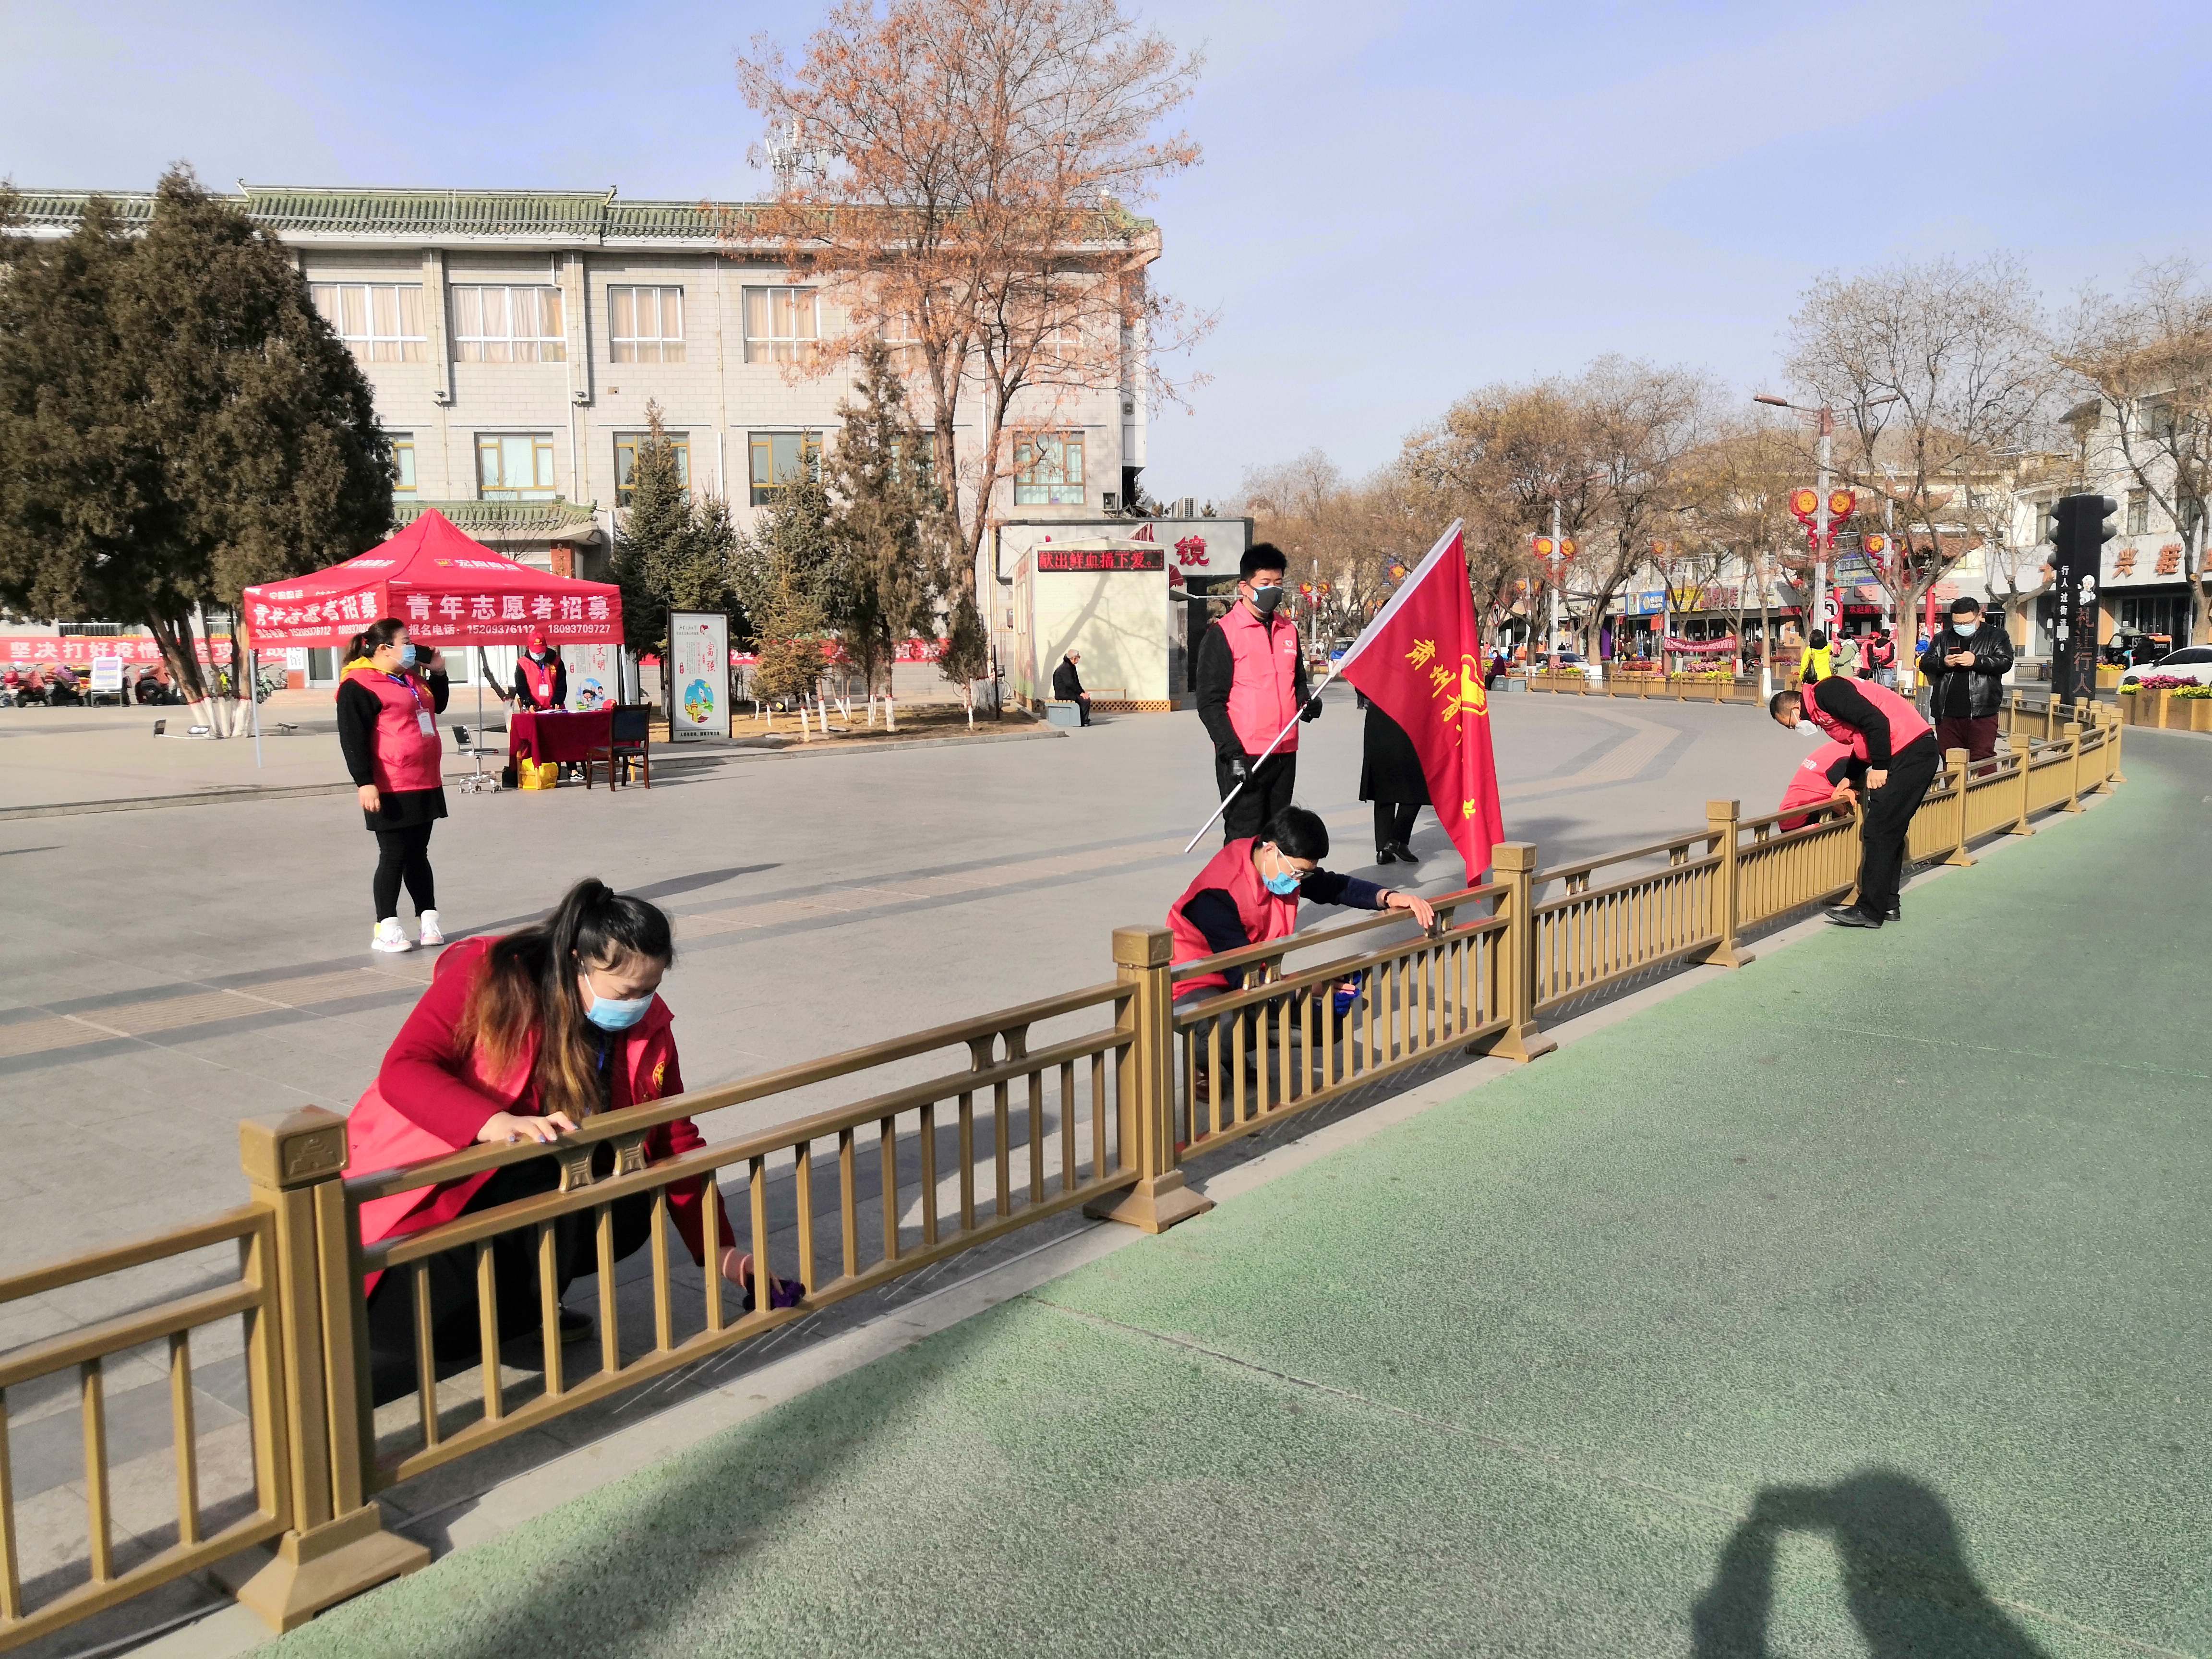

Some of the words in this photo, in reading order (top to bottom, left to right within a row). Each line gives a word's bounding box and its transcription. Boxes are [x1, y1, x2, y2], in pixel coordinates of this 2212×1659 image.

[1039, 552, 1152, 568] 献出鲜血播下爱。
[1174, 535, 1210, 566] 镜
[253, 591, 378, 626] 青年志愿者招募
[406, 593, 611, 621] 青年志愿者招募
[2059, 565, 2069, 641] 行人过街请
[467, 625, 535, 634] 15209376112
[548, 625, 610, 634] 18093709727
[596, 644, 606, 671] 文明
[707, 641, 715, 672] 富强
